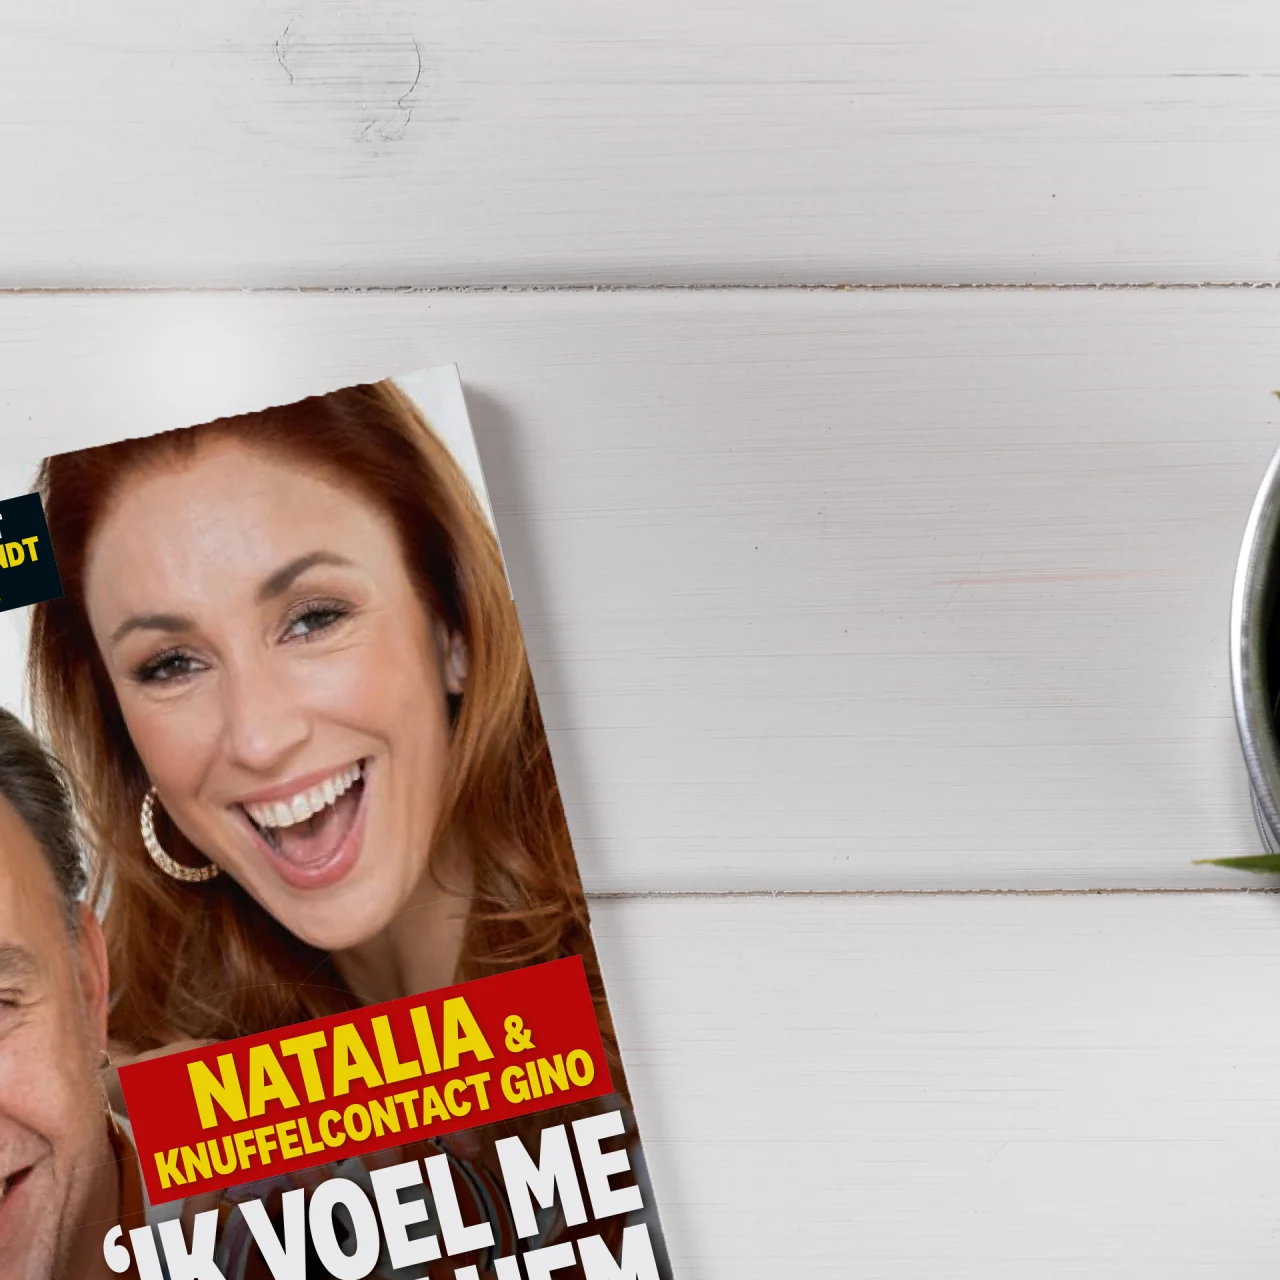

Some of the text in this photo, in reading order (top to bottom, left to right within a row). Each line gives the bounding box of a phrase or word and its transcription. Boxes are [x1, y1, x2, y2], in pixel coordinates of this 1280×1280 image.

[154, 1049, 595, 1189] KNUFFELCONTACT GINO
[187, 996, 536, 1129] NATALIA &
[495, 1110, 644, 1239] ME
